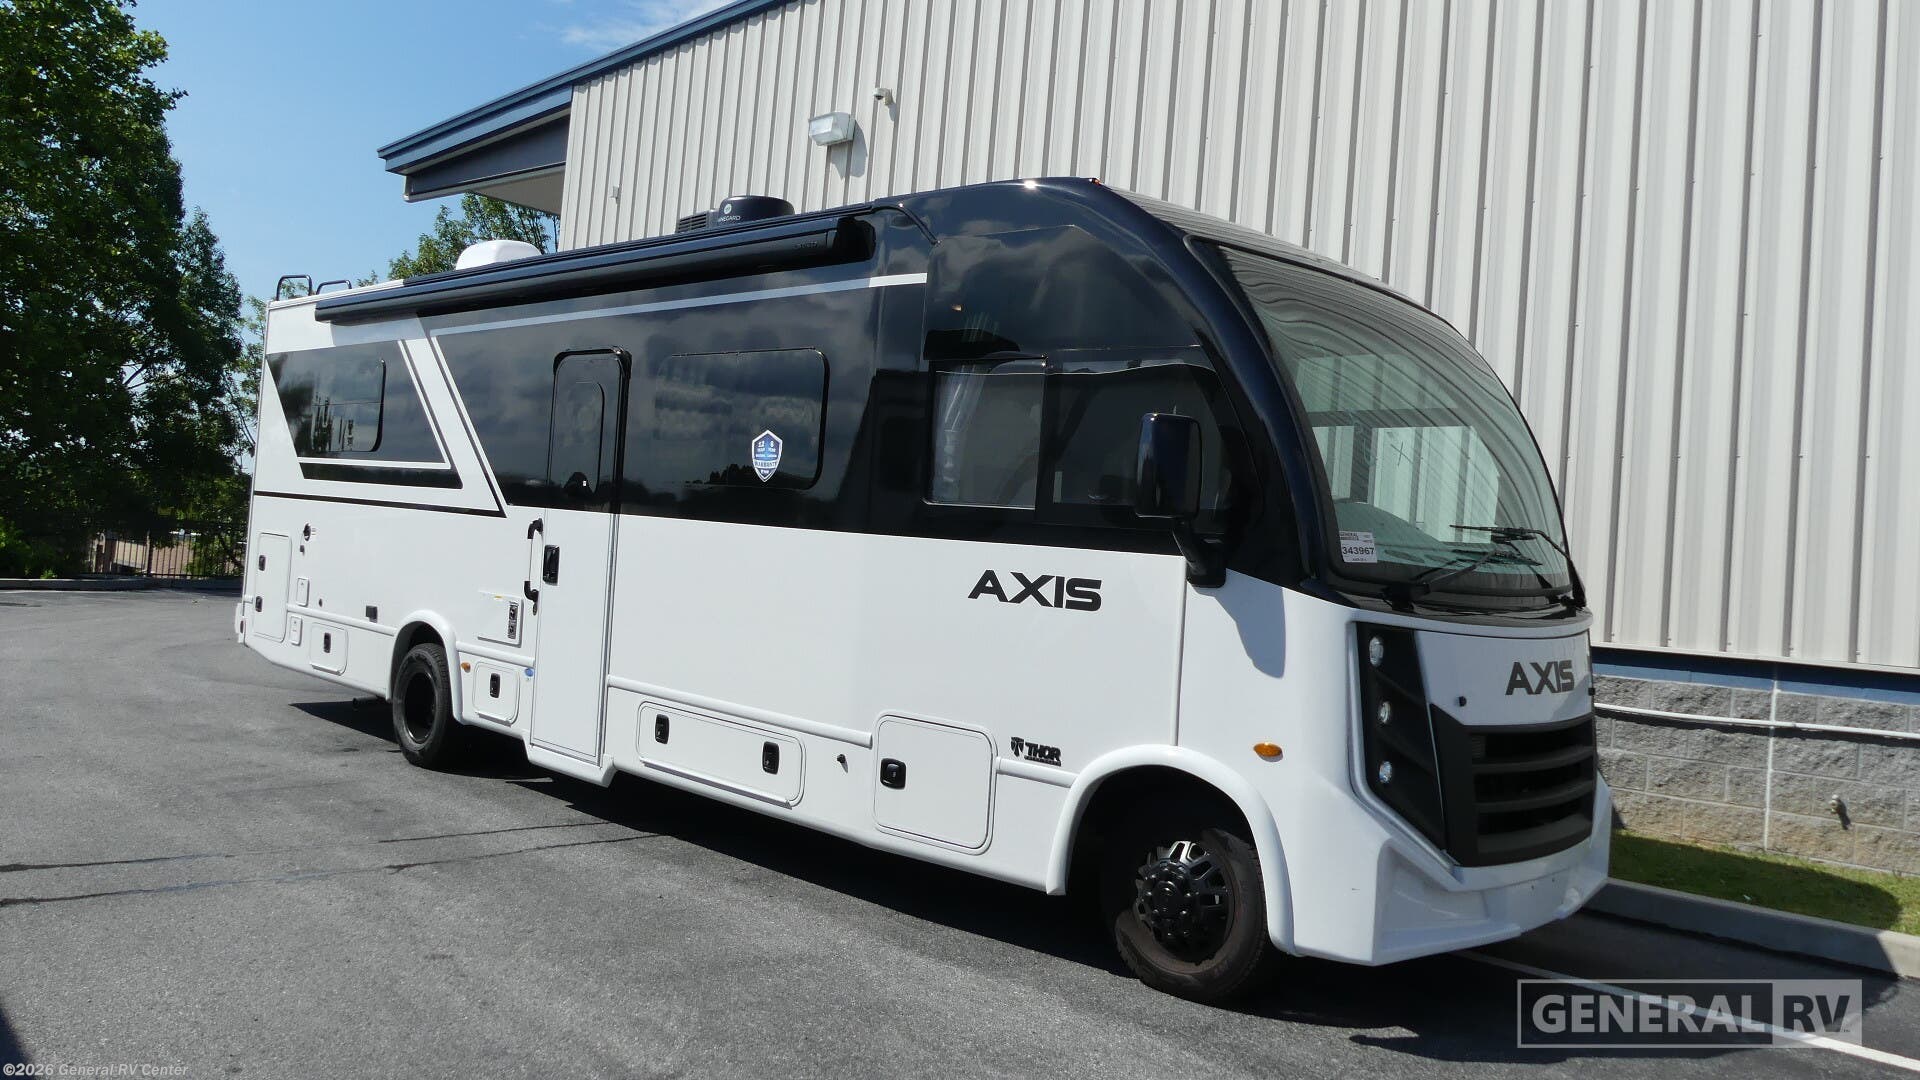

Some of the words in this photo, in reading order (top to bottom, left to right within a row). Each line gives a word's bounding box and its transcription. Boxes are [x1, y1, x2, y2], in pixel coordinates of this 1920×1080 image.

[1342, 546, 1375, 555] 343967
[968, 569, 1102, 611] AXIS
[1505, 660, 1575, 695] AXIS
[1025, 741, 1061, 761] THOR
